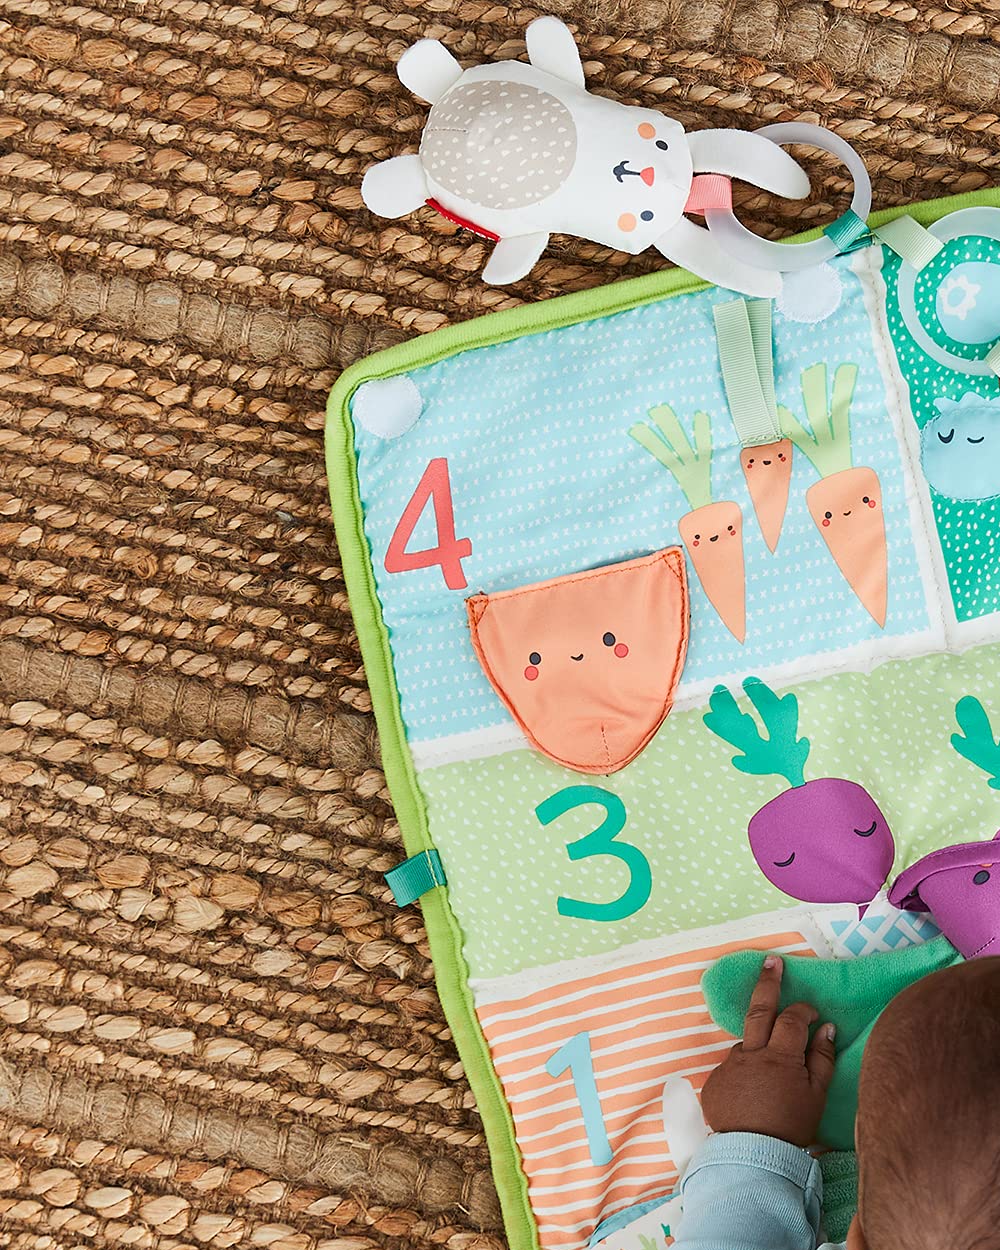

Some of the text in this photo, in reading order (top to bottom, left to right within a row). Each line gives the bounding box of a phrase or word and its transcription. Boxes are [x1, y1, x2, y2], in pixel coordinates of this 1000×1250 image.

[385, 458, 472, 590] 4
[535, 785, 652, 922] 3
[545, 1031, 613, 1166] 1
